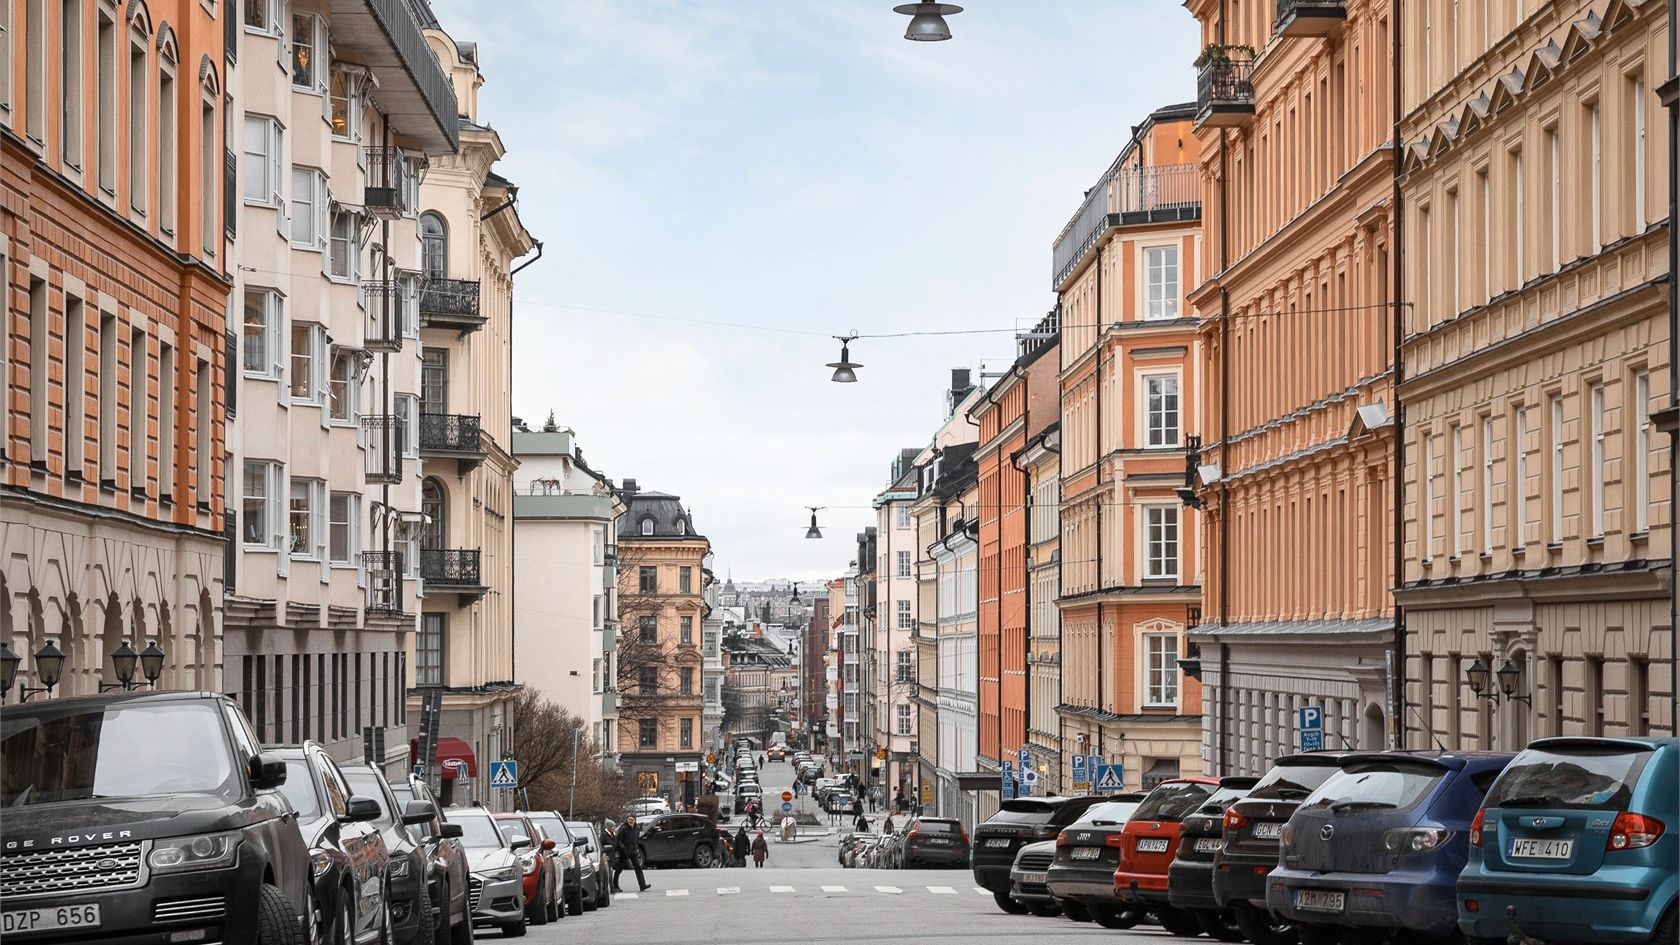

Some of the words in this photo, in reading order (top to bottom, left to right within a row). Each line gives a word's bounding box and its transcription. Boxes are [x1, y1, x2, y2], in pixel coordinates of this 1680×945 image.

[1304, 708, 1318, 728] P
[1020, 750, 1028, 760] P
[1075, 756, 1083, 768] P
[1004, 761, 1011, 771] P
[1257, 823, 1272, 835] GCN
[51, 830, 131, 845] ROVER
[1514, 840, 1538, 856] WFE
[1545, 841, 1569, 857] 410
[1298, 892, 1317, 906] XZM
[1323, 894, 1342, 908] 795
[3, 911, 41, 932] DZP
[57, 906, 96, 926] 656
